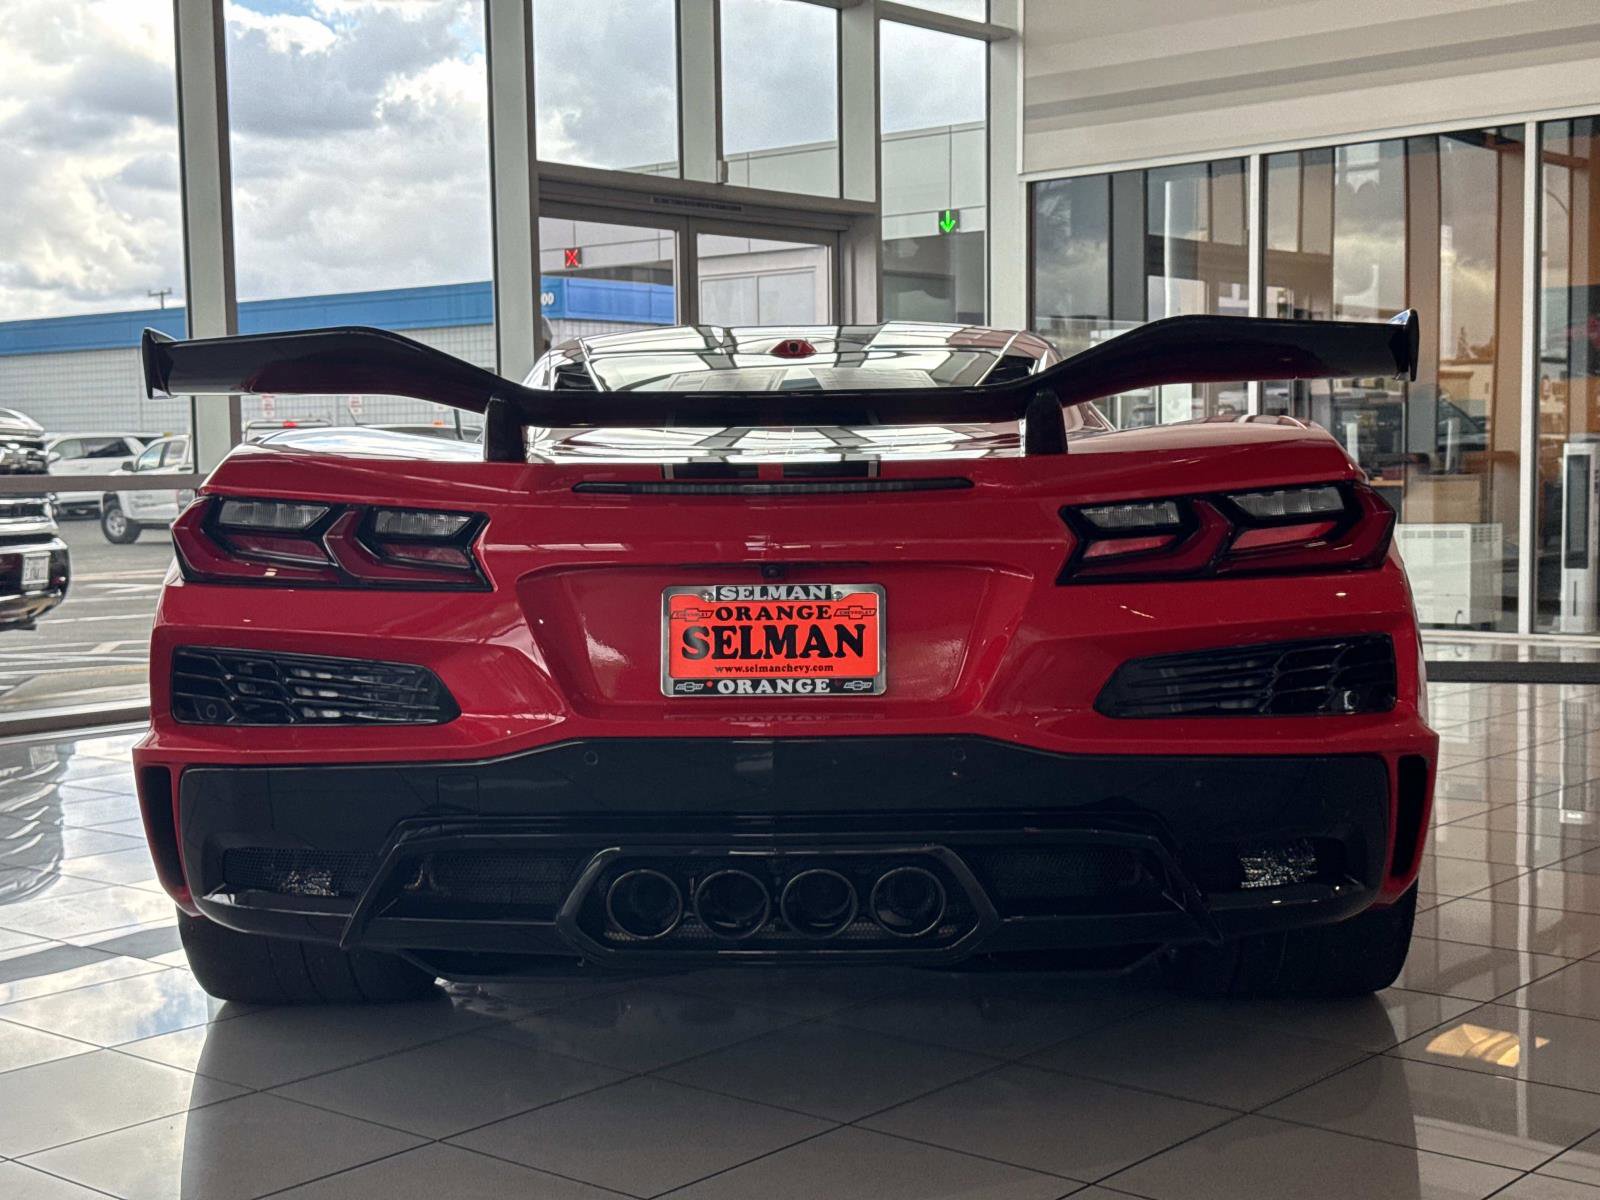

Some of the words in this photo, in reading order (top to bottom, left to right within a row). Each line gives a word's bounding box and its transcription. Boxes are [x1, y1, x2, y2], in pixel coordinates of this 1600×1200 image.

[720, 586, 827, 600] SELMAN
[715, 606, 832, 621] ORANGE
[682, 624, 865, 659] SELMAN
[715, 664, 834, 673] www.selmanchevy.com
[717, 679, 830, 694] ORANGE
